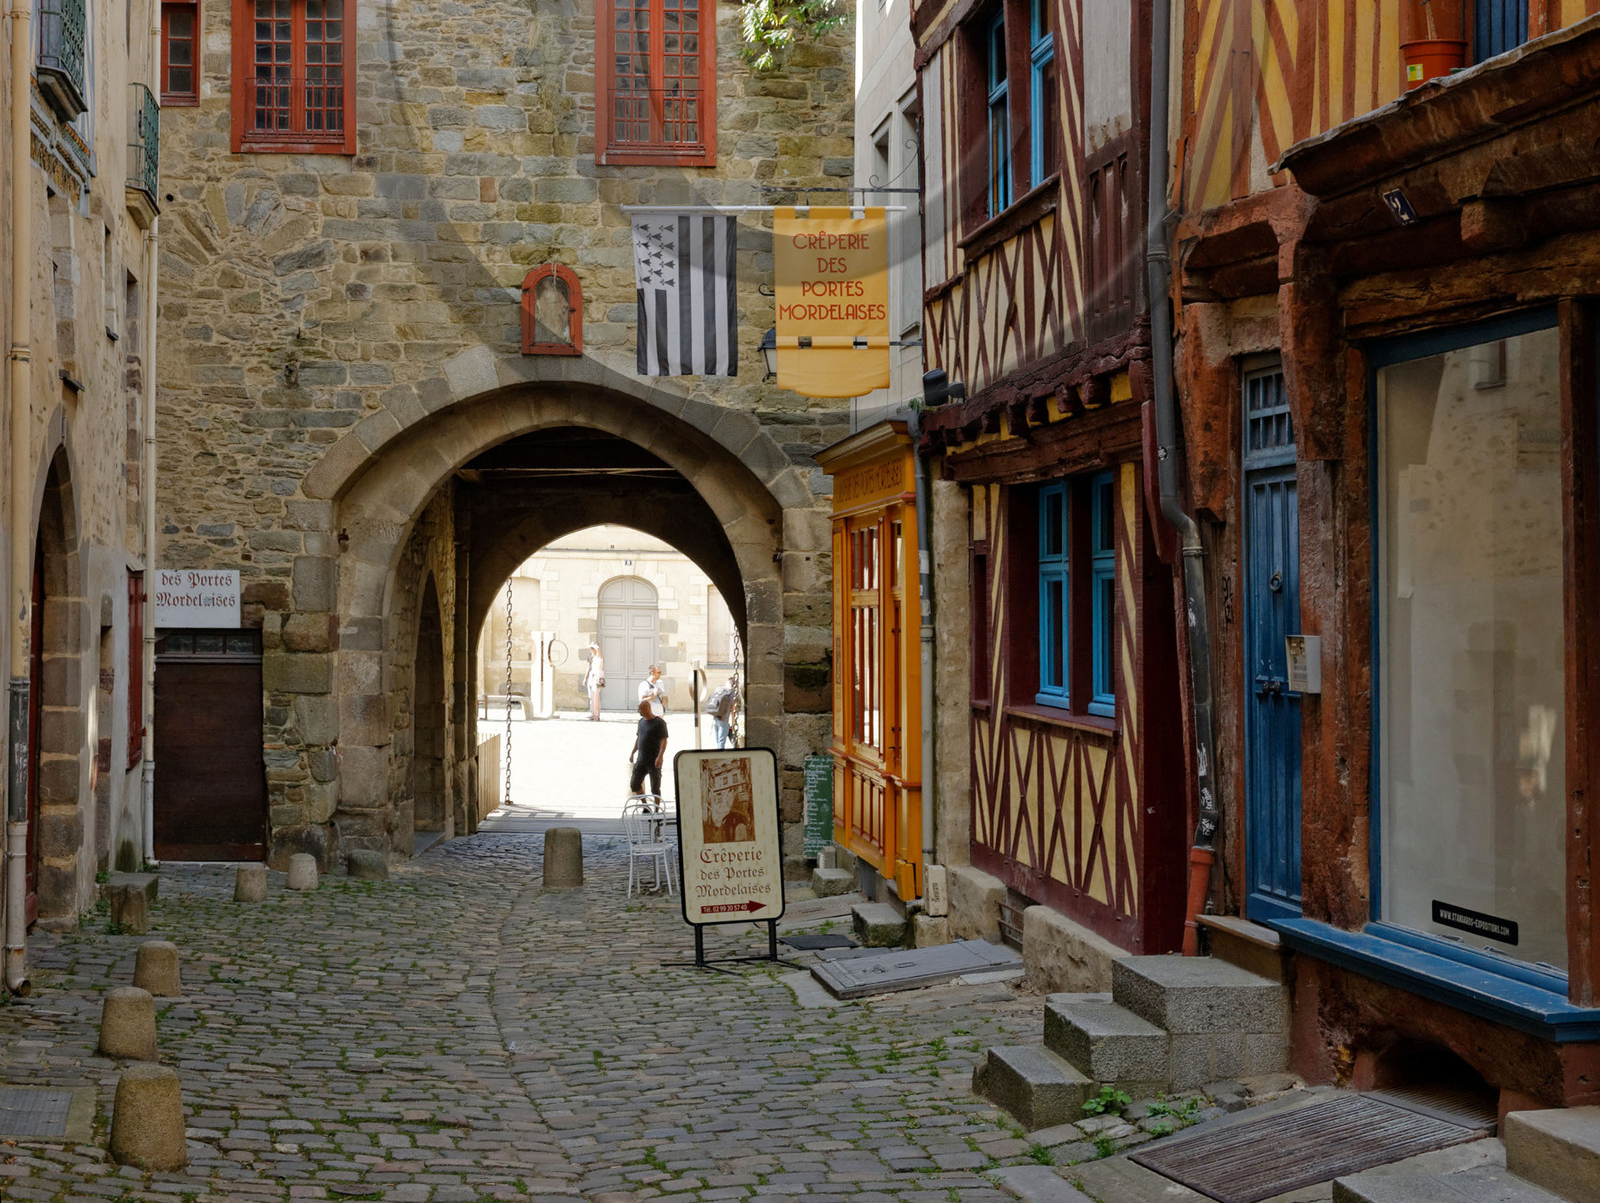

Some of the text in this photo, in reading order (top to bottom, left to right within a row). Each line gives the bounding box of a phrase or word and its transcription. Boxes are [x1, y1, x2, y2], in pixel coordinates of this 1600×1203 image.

[793, 230, 869, 250] CRÊPERIE
[817, 257, 847, 273] DES
[801, 280, 864, 297] PORTES
[779, 304, 886, 321] MORDELAISES
[161, 571, 233, 589] des Portes
[155, 592, 236, 607] Mordelises
[700, 846, 762, 865] Crêperie
[700, 867, 765, 881] des Portes
[695, 882, 771, 898] Mordelaises
